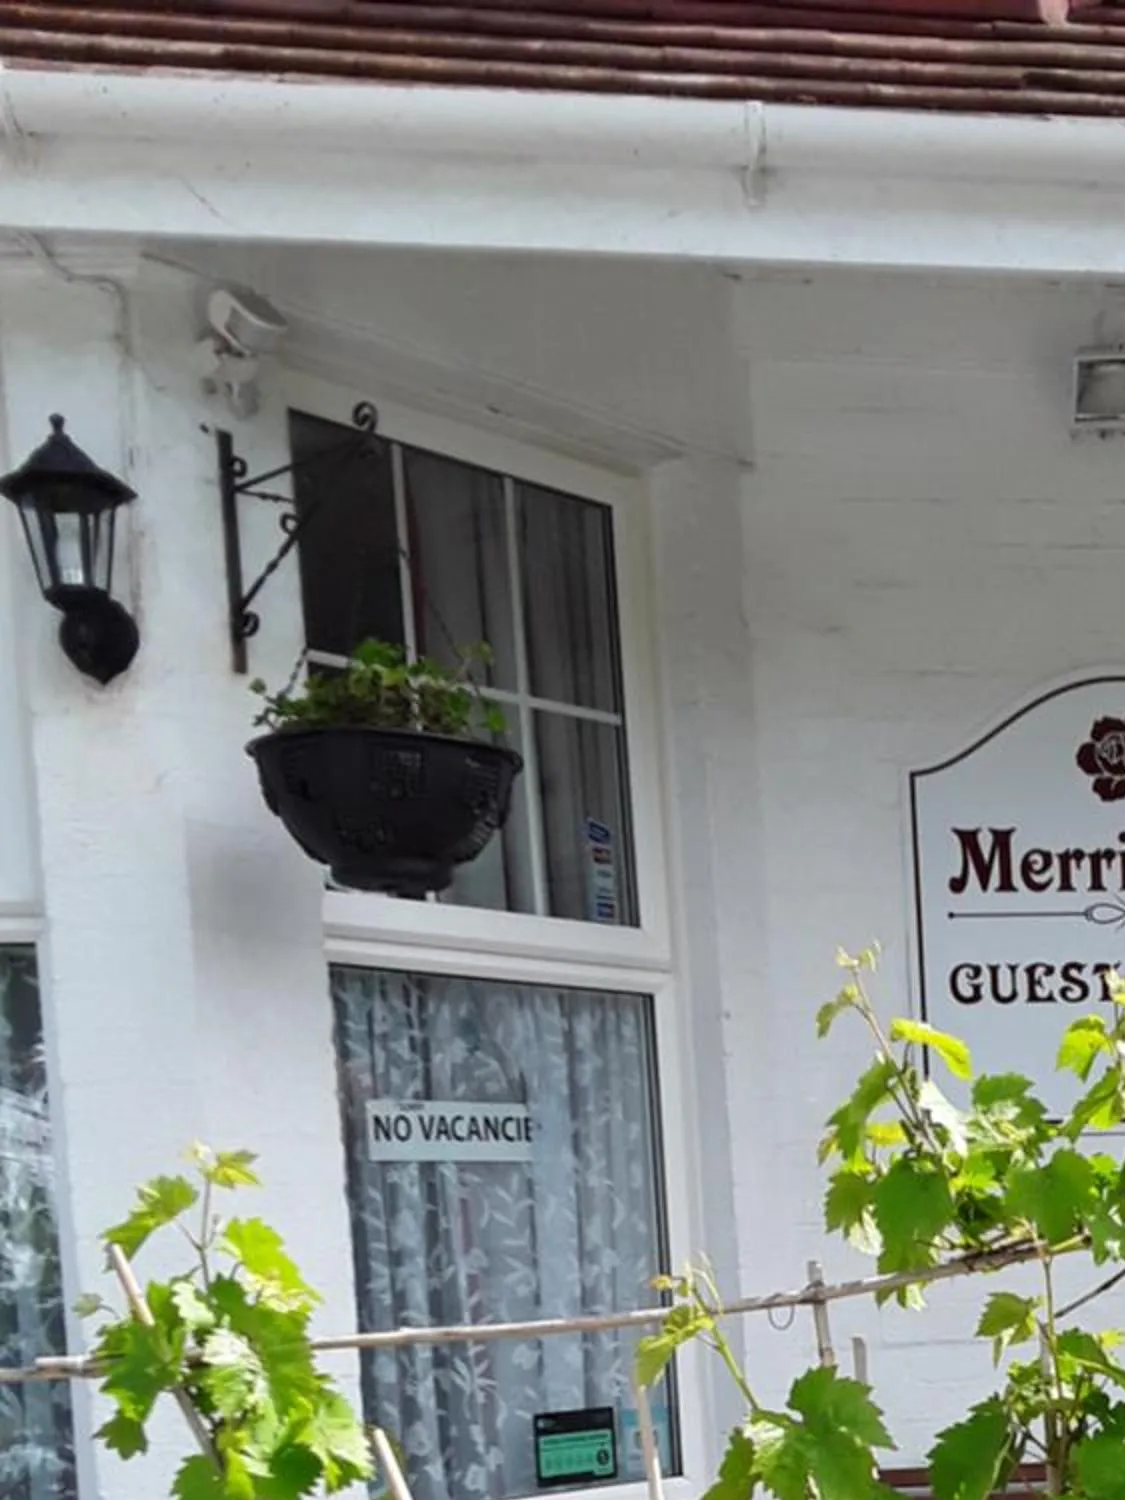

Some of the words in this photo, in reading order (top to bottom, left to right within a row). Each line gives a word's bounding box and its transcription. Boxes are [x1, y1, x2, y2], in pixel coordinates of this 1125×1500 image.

[949, 961, 1122, 1004] GUEST
[373, 1114, 412, 1142] NO
[418, 1115, 538, 1142] VACANCIE
